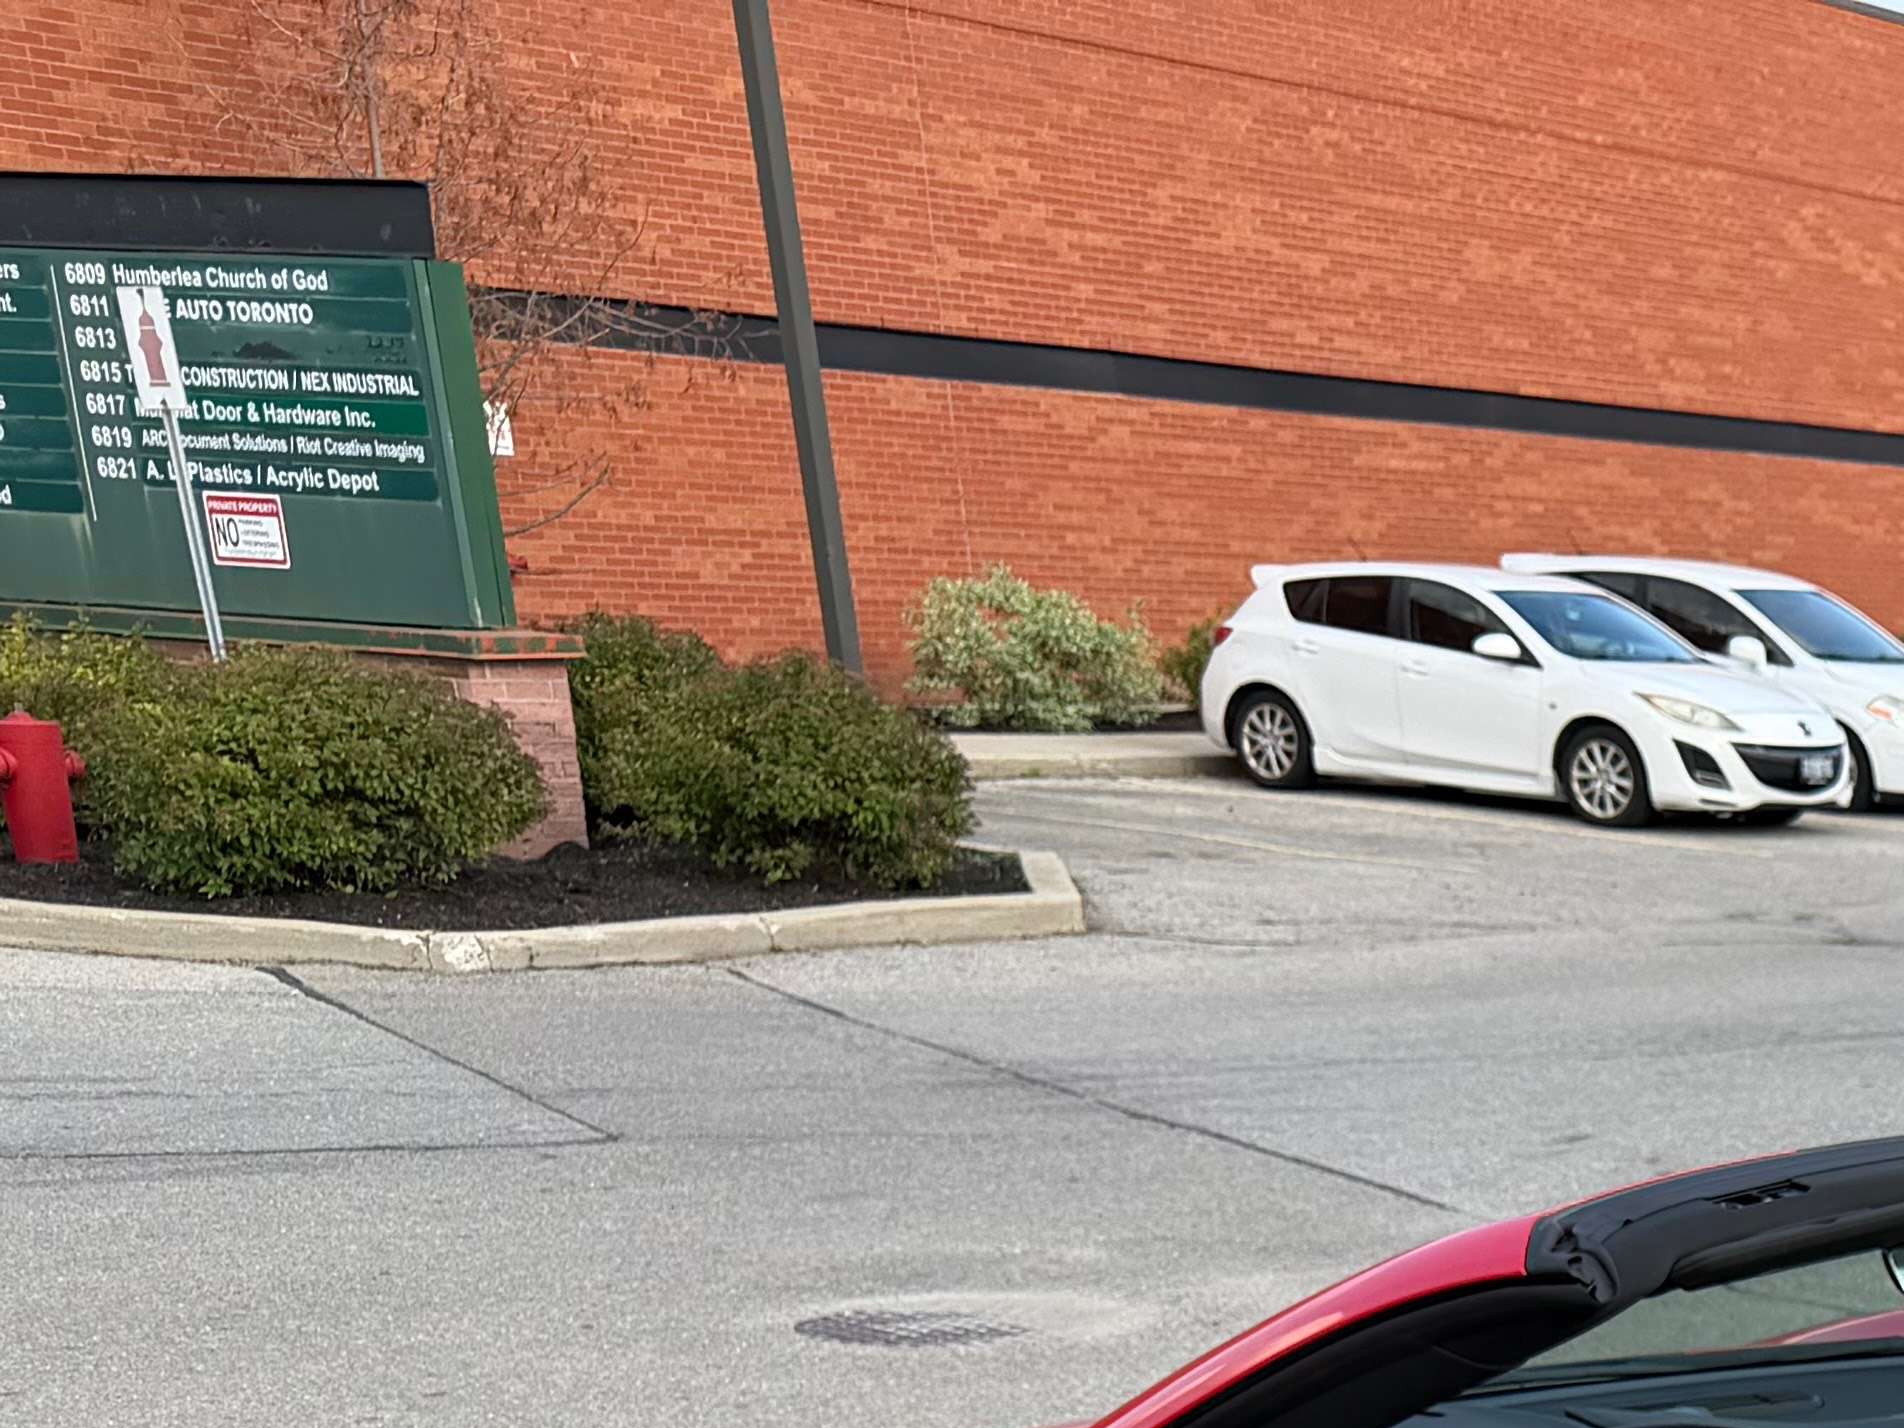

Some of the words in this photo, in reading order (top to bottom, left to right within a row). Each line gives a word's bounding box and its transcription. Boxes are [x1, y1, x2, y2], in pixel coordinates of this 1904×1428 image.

[65, 262, 105, 285] 6809
[112, 263, 201, 287] Humberlea
[206, 267, 266, 289] Church
[271, 268, 288, 290] of
[292, 269, 328, 291] God
[70, 294, 109, 317] 6811
[176, 298, 223, 321] AUTO
[226, 300, 313, 324] TORONTO
[75, 326, 116, 349] 6813
[80, 360, 121, 383] 6815
[180, 366, 289, 390] CONSTRUCTION
[301, 371, 331, 392] NEX
[333, 373, 420, 396] INDUSTRIAL
[86, 393, 125, 415] 6817
[203, 400, 242, 421] Door
[247, 401, 260, 422] &
[263, 402, 341, 426] Hardware
[345, 405, 376, 428] Inc.
[91, 425, 132, 448] 6819
[179, 432, 230, 450] ocument
[232, 432, 288, 454] Solutions
[296, 436, 321, 455] Riot
[324, 437, 373, 457] Creative
[374, 440, 425, 463] Imaging
[97, 456, 137, 479] 6821
[187, 461, 253, 484] Plastics
[266, 466, 324, 492] Acrylic
[327, 468, 380, 495] Depot
[215, 517, 239, 547] NO
